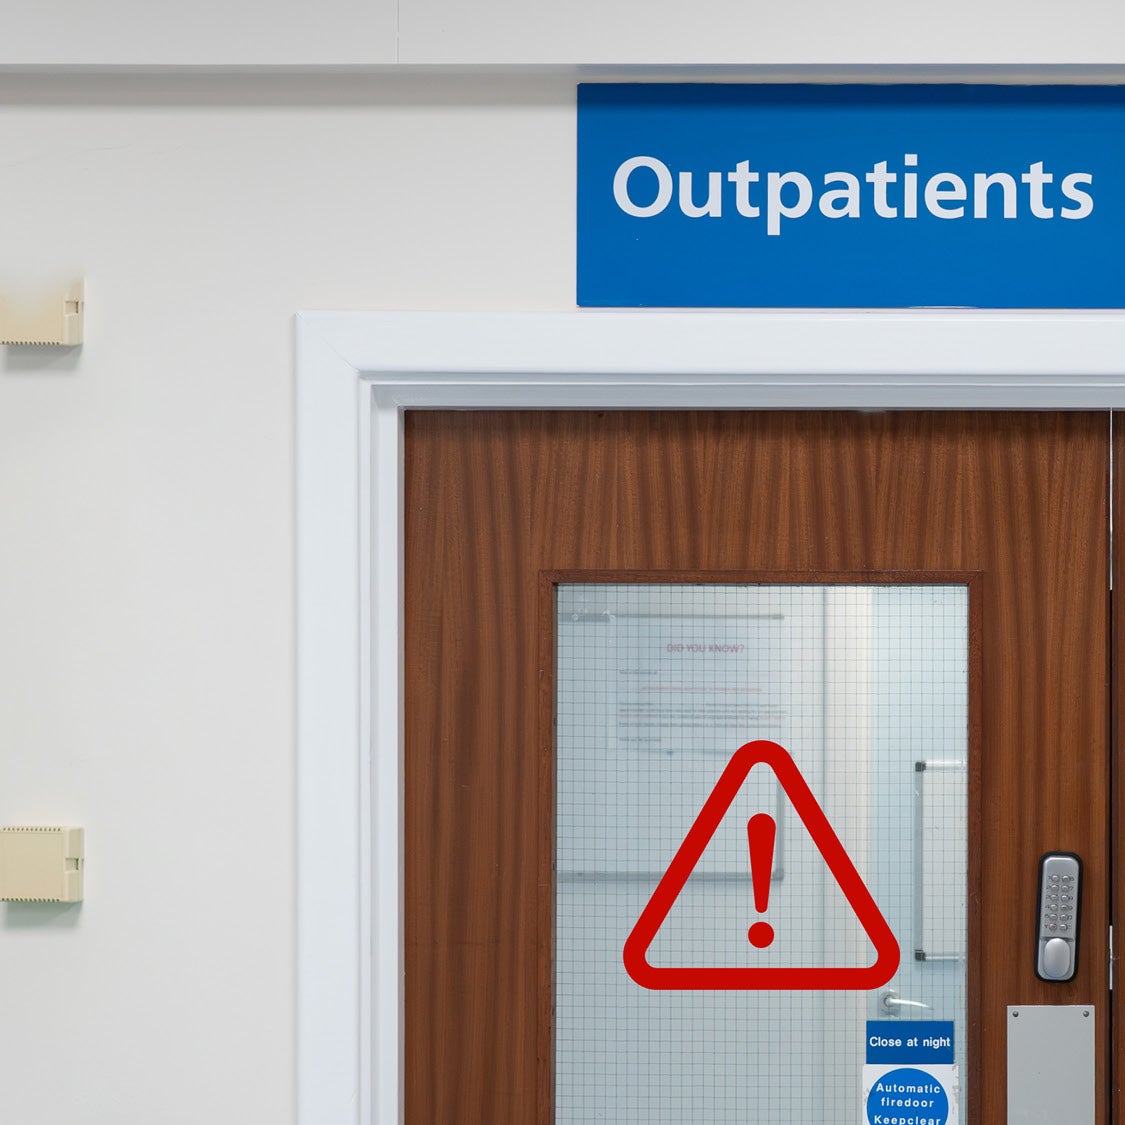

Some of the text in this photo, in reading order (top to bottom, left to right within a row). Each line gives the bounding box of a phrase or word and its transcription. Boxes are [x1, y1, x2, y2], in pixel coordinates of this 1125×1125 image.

[613, 153, 1094, 235] Outpatients
[666, 644, 745, 654] DID YOU KNOW?
[869, 1036, 951, 1049] Close at night
[876, 1083, 941, 1094] Automatic
[881, 1097, 934, 1108] firedoor
